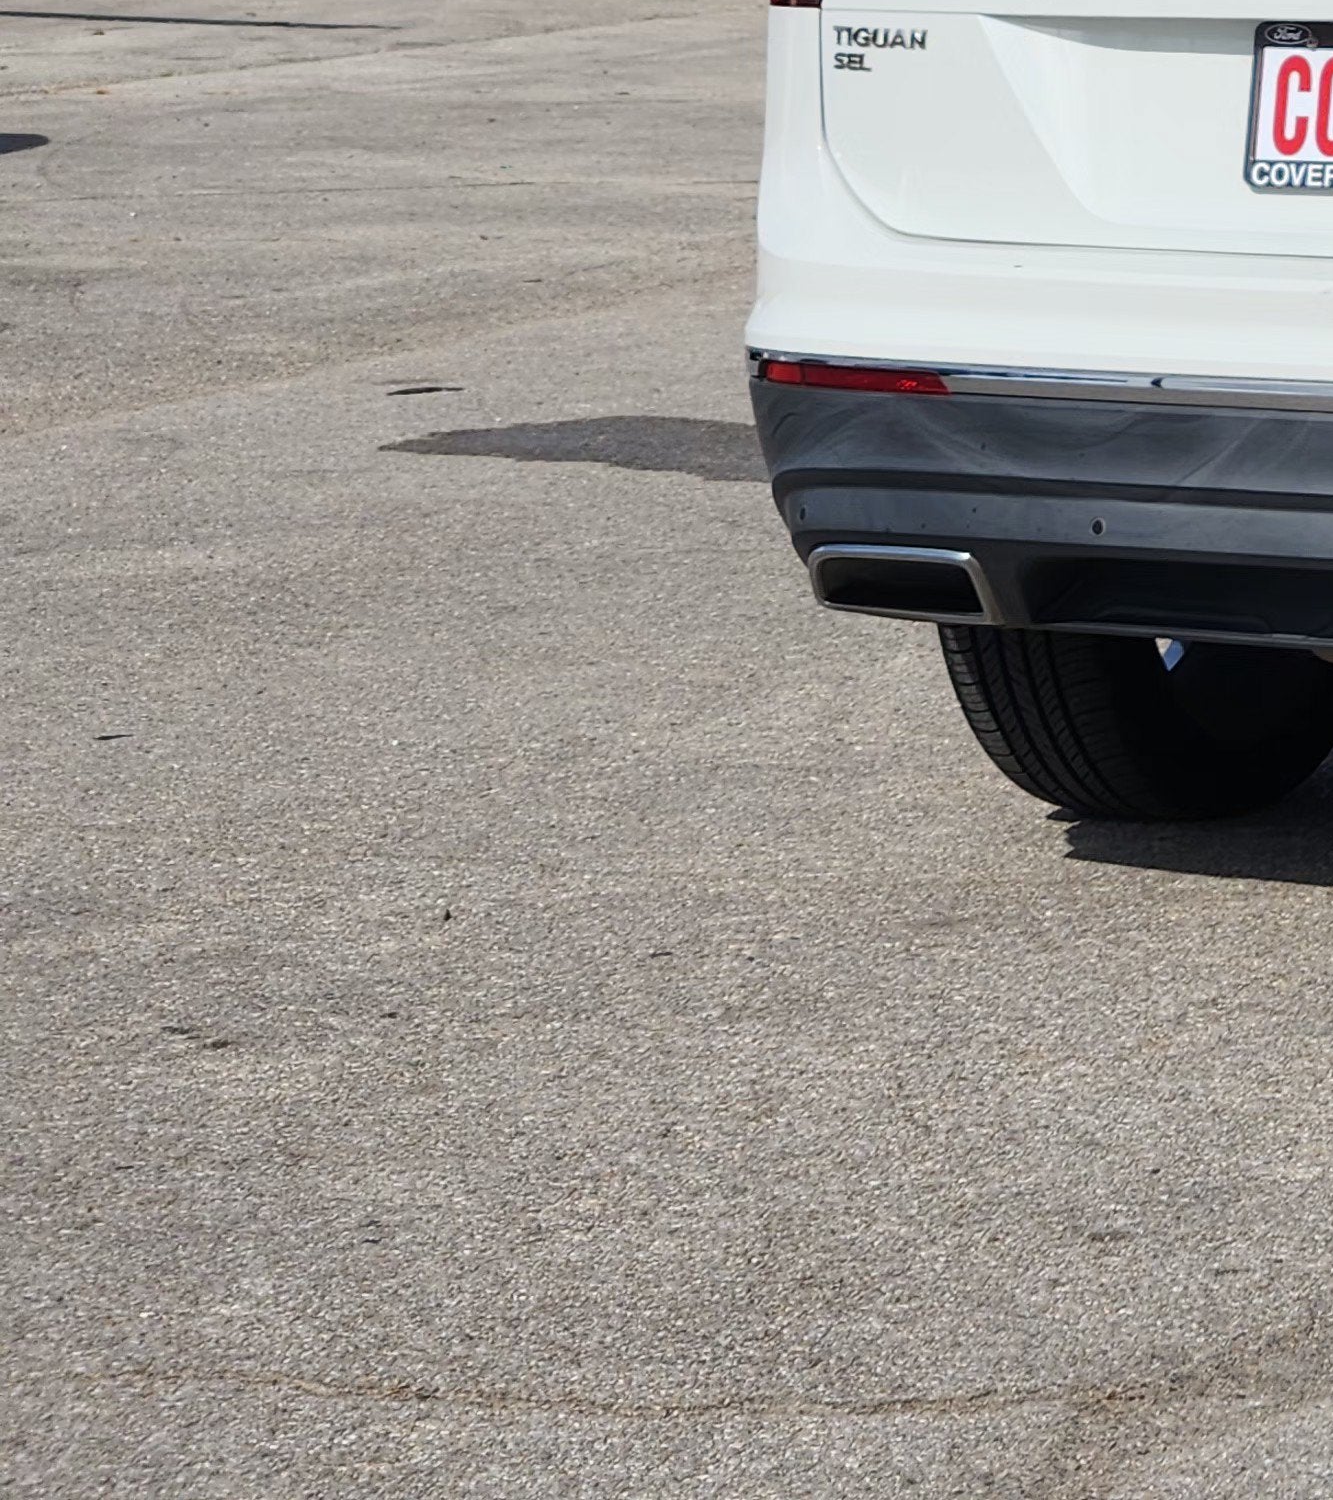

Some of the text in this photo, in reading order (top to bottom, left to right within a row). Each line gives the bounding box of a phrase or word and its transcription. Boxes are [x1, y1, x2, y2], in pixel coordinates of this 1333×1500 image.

[833, 26, 928, 50] TIGUAN
[1272, 26, 1302, 41] Ford
[833, 52, 872, 72] SEL
